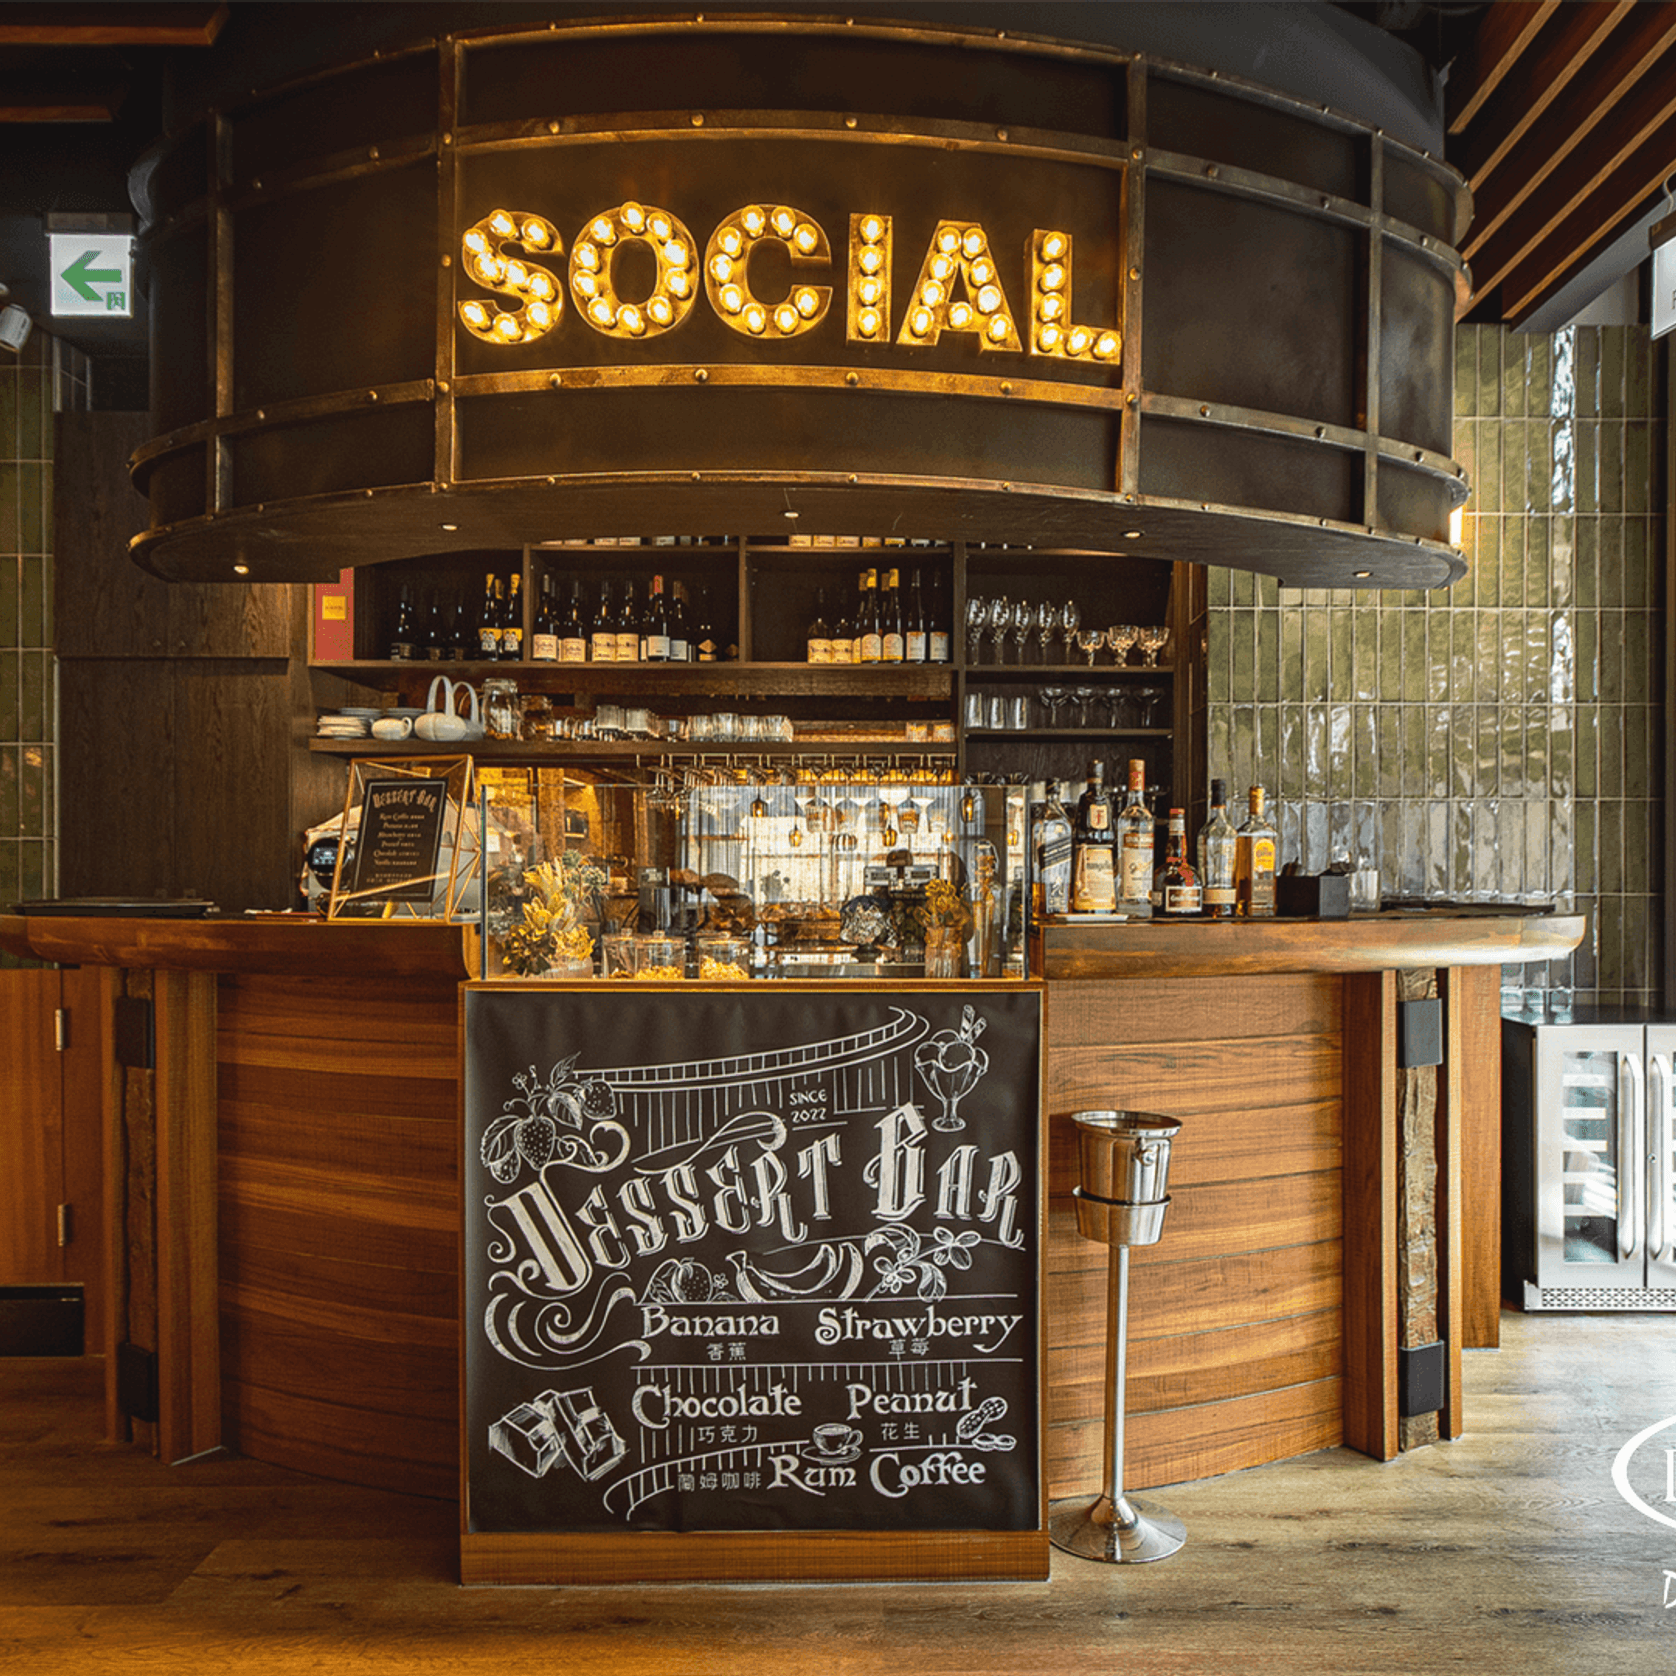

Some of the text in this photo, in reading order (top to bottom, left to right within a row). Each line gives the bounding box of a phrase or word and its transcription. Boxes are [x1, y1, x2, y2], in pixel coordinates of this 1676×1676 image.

[457, 201, 1122, 365] SOCIAL
[789, 1089, 827, 1106] SINCE
[791, 1107, 827, 1123] 2022
[640, 1304, 1024, 1353] Banana Strawberry
[706, 1337, 930, 1361] 香蕉 草莓
[631, 1376, 978, 1429] Chocolate Peanut
[697, 1422, 920, 1444] 巧克力 花生
[767, 1454, 857, 1496] Rum
[869, 1451, 986, 1498] Coffee
